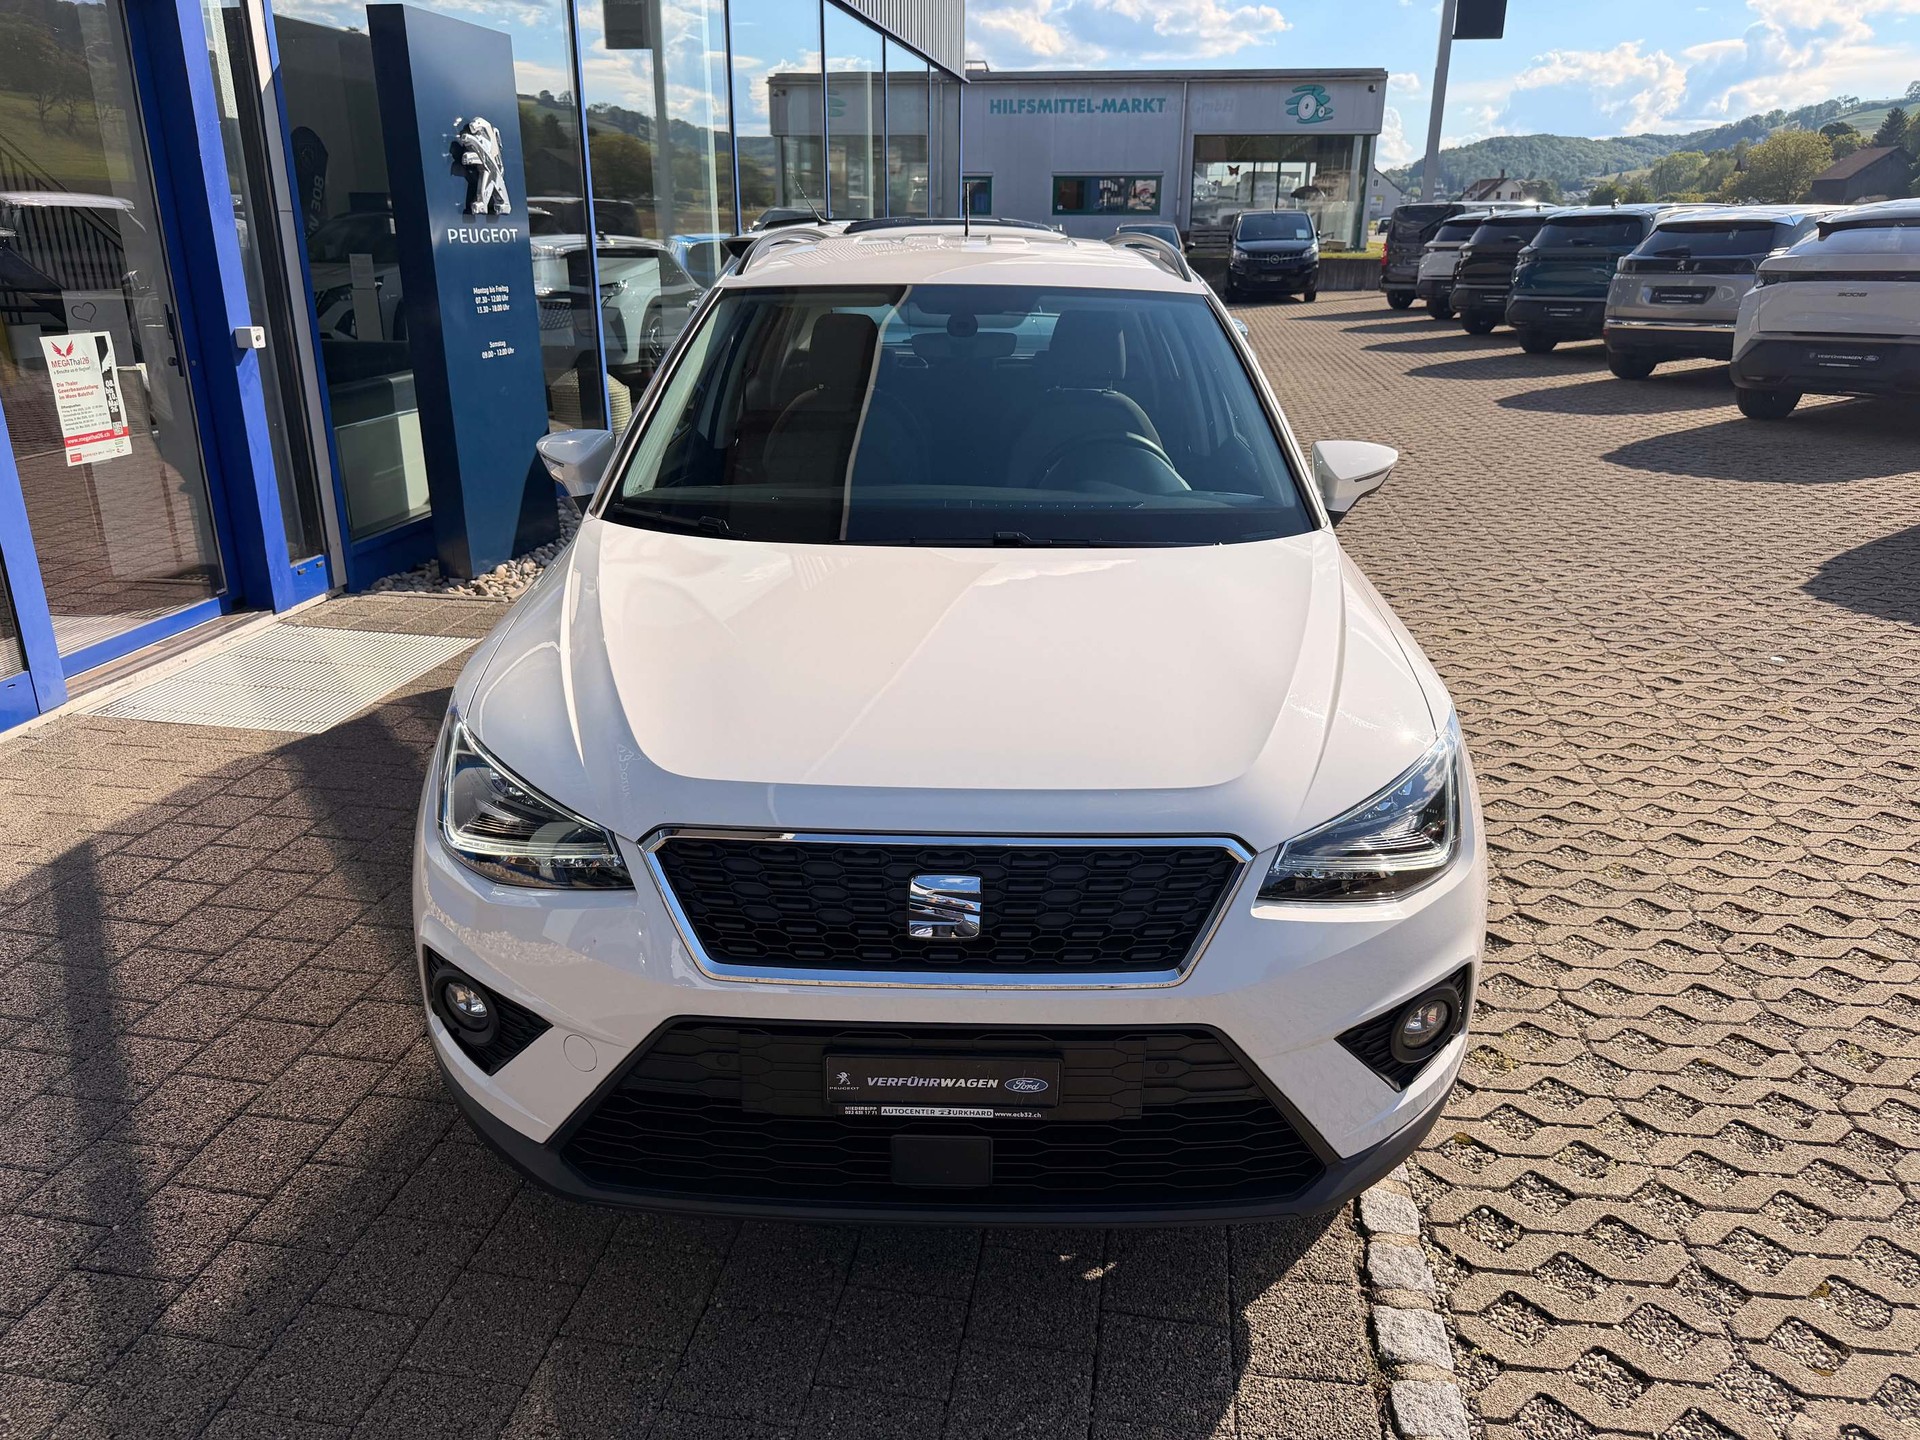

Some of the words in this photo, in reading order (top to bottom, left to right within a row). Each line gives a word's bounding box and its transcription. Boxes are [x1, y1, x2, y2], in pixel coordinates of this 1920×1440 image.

[989, 98, 1166, 114] HILFSMITTEL-MARKT
[447, 228, 518, 244] PEUGEOT
[473, 286, 489, 295] Montag
[496, 285, 509, 294] Freitag
[489, 340, 506, 349] Samstag
[51, 356, 90, 368] MEGAThal26
[867, 1075, 998, 1089] VERFÜHRWAGEN
[947, 1108, 993, 1117] BURKHARD
